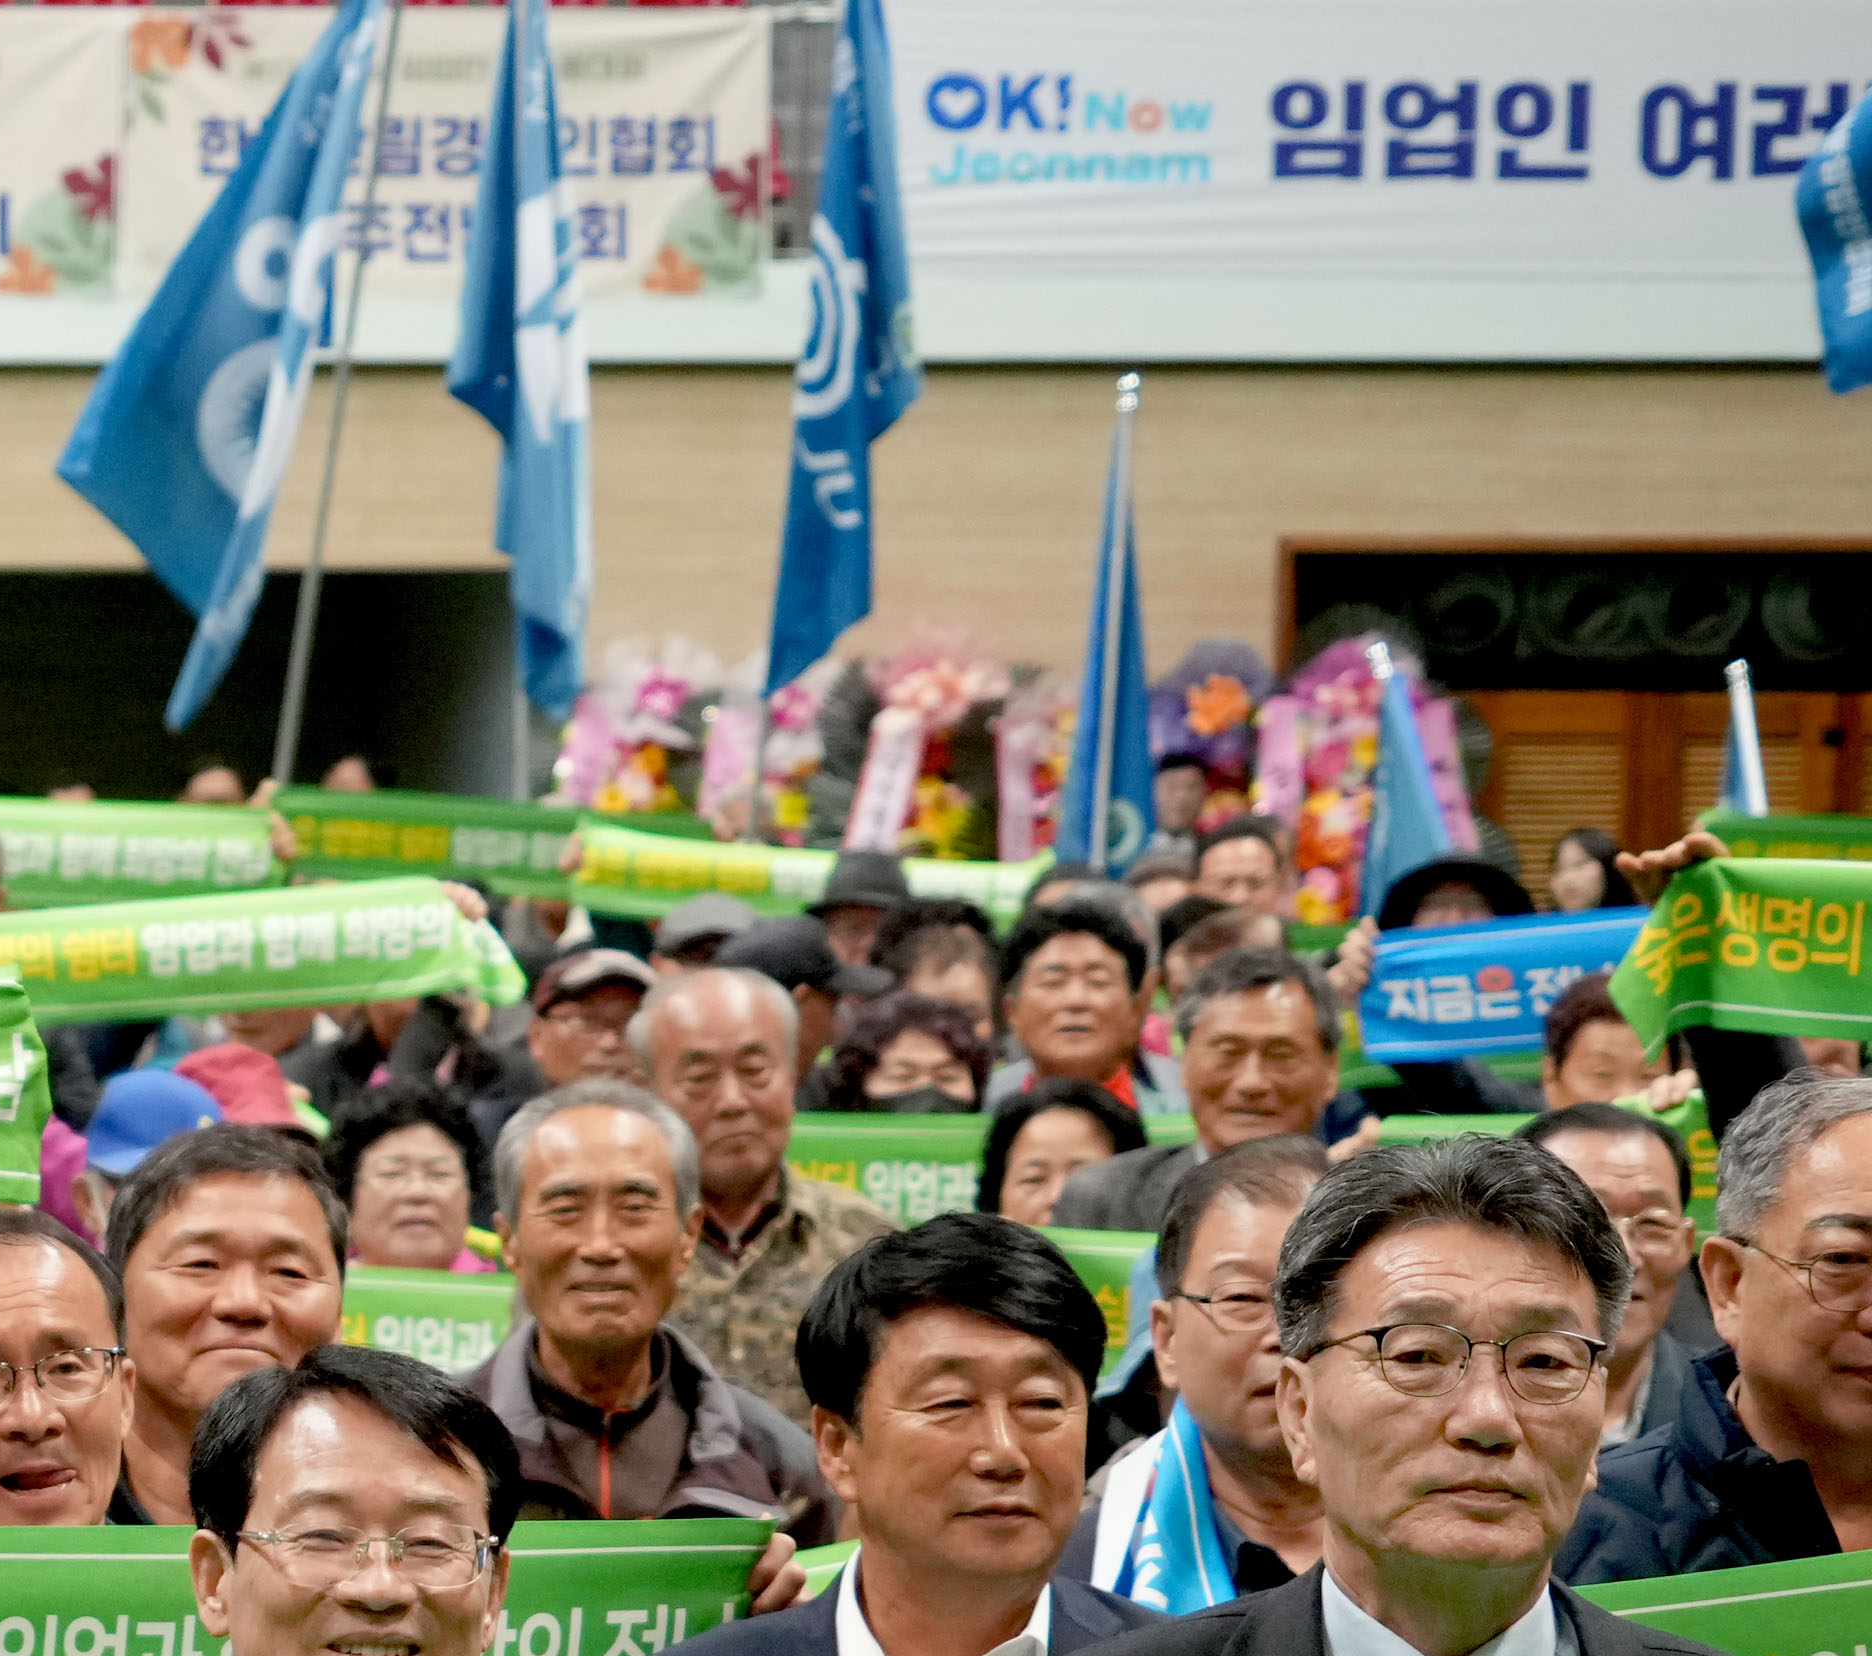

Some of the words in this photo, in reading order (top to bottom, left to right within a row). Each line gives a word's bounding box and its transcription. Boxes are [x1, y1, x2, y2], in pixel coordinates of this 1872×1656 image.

[925, 71, 1072, 134] OK!
[1085, 93, 1215, 136] Now
[1269, 80, 1592, 182] 임업인
[928, 143, 1212, 186] Jeonnam
[1715, 890, 1865, 977] 생명의
[1382, 963, 1522, 1024] 지금은
